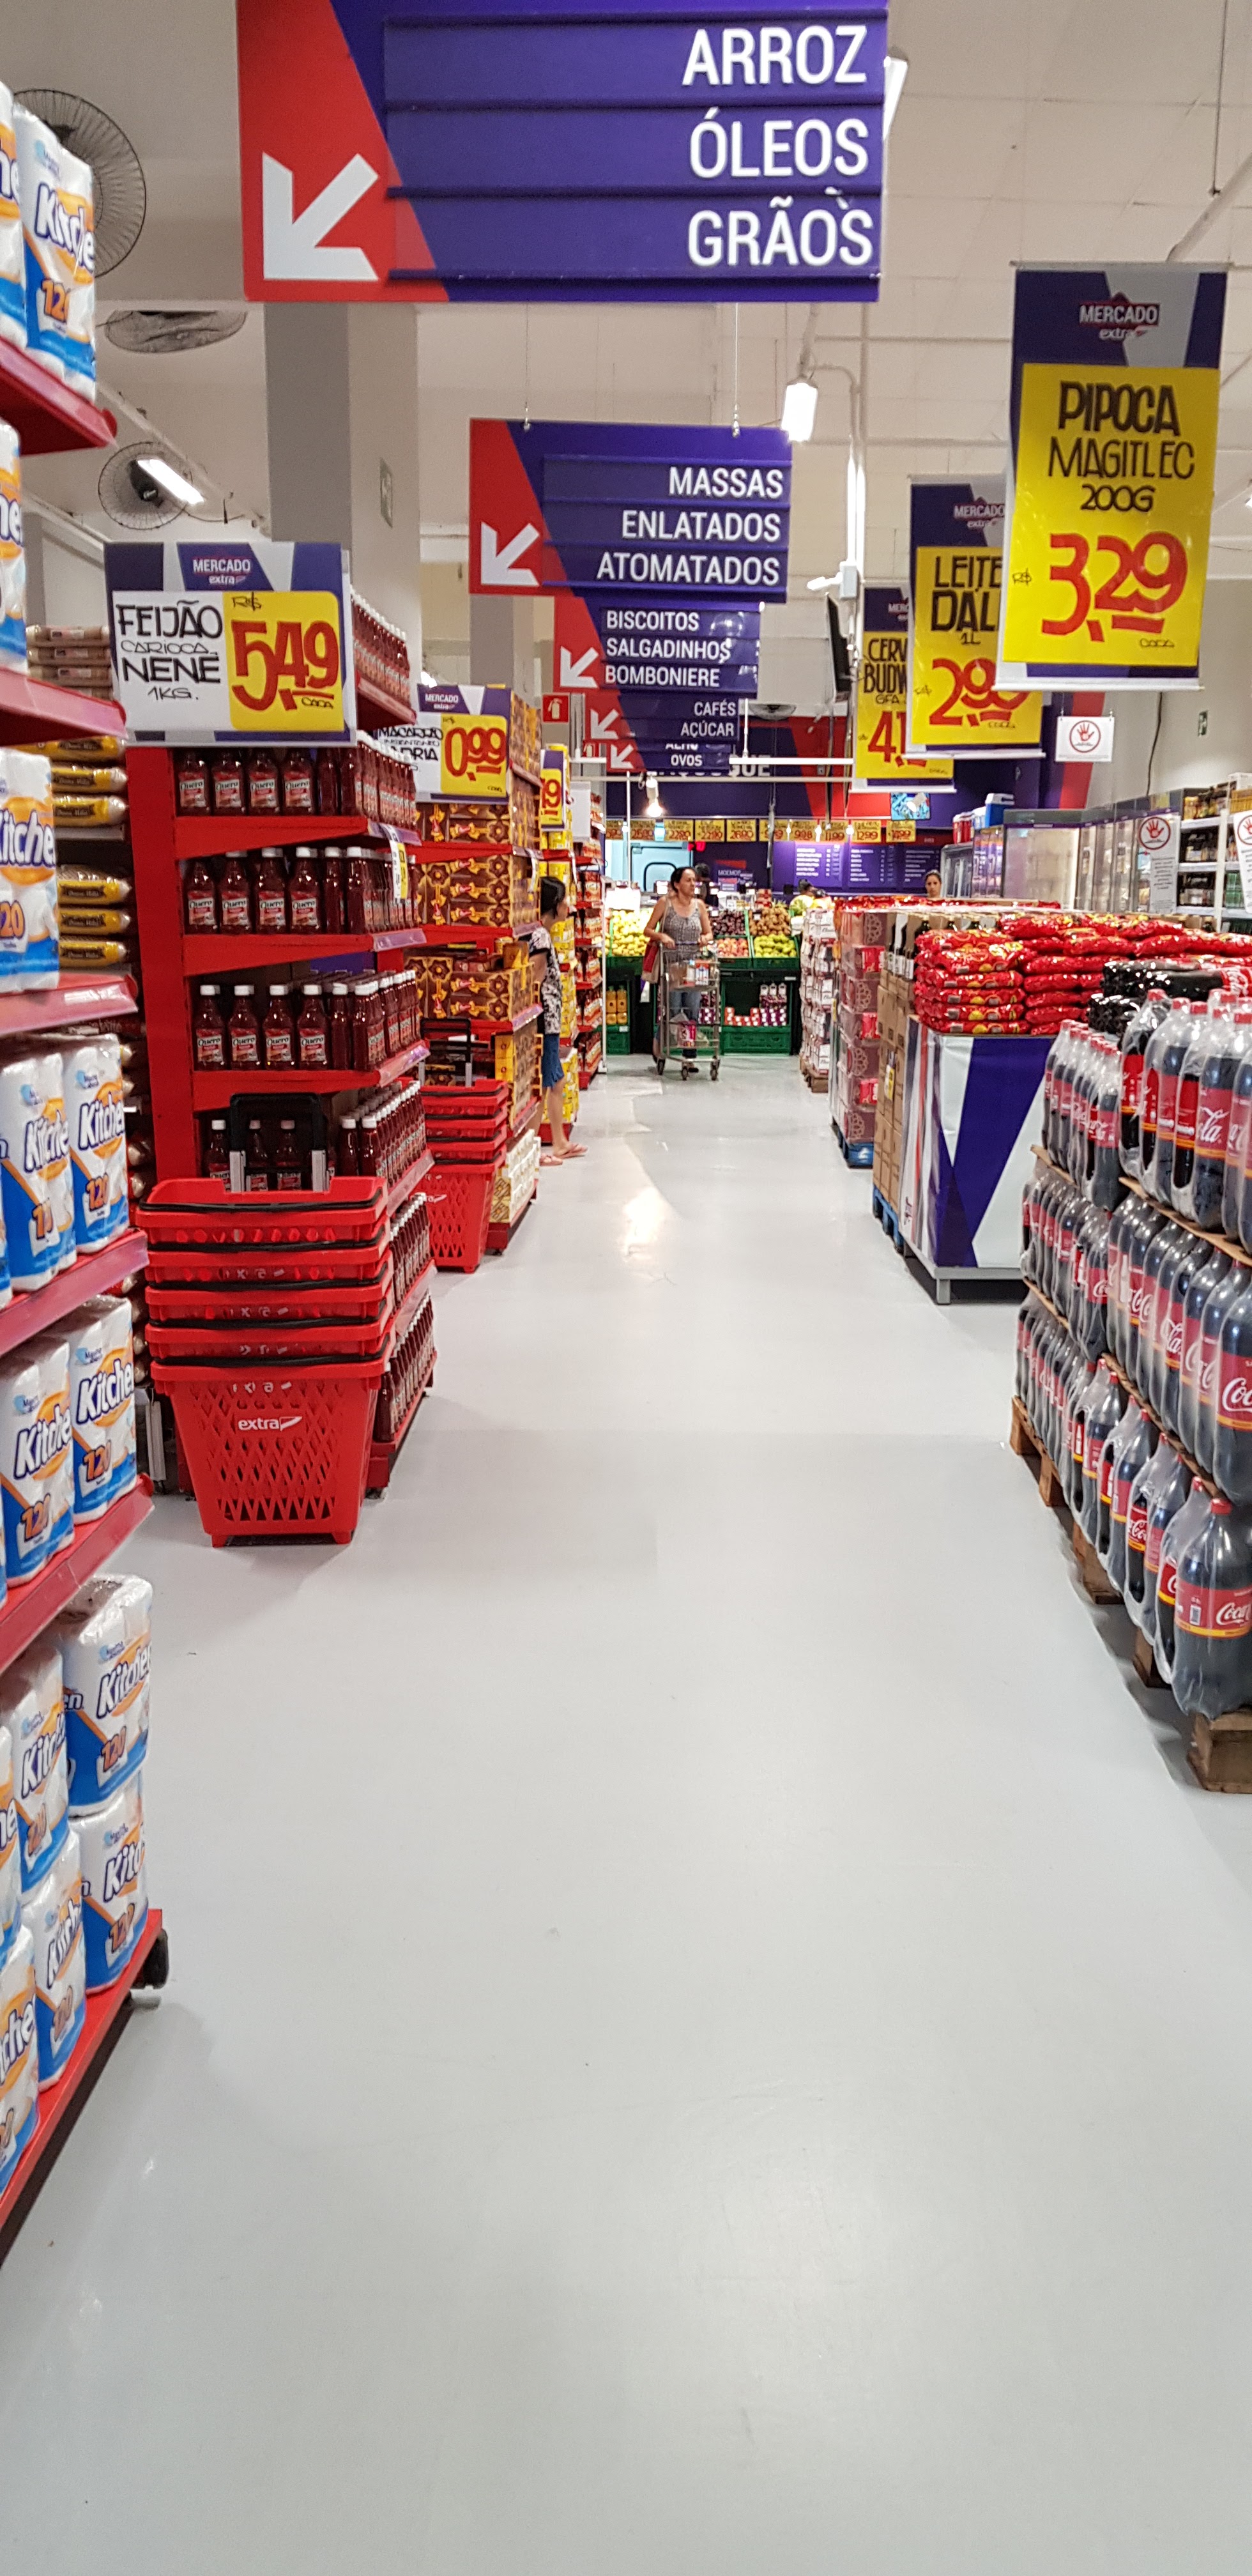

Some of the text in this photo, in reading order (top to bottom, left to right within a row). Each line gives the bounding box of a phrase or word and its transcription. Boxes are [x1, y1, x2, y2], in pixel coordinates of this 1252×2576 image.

[682, 25, 867, 86] ARROZ
[689, 108, 869, 178] ÓLEOS
[687, 195, 873, 266] GRÃOS
[1079, 305, 1159, 325] MERCADO
[1058, 380, 1182, 437] PIPOCA
[1048, 436, 1195, 480] MAGITLEC
[669, 466, 783, 500] MASSAS
[1080, 483, 1157, 512] 200G
[622, 510, 781, 543] ENLATADOS
[193, 558, 251, 572] MERCADO
[208, 574, 236, 585] extra
[597, 551, 779, 586] ATOMATADOS
[935, 555, 1003, 588] LEITE
[1041, 531, 1188, 643] 3,29
[116, 600, 223, 638] FEIJÃO
[606, 610, 700, 631] BISCOITOS
[121, 640, 210, 654] CARIOCA
[606, 637, 731, 661] SALGADINHOS
[231, 620, 340, 711] 5,49
[605, 664, 720, 687] BOMBONIERE
[425, 693, 459, 703] MERCADO
[694, 699, 736, 716] CAFÉS
[680, 720, 735, 738] AÇÚCAR
[444, 726, 507, 782] 0,99
[671, 754, 703, 767] OVOS
[238, 1416, 280, 1430] extra
